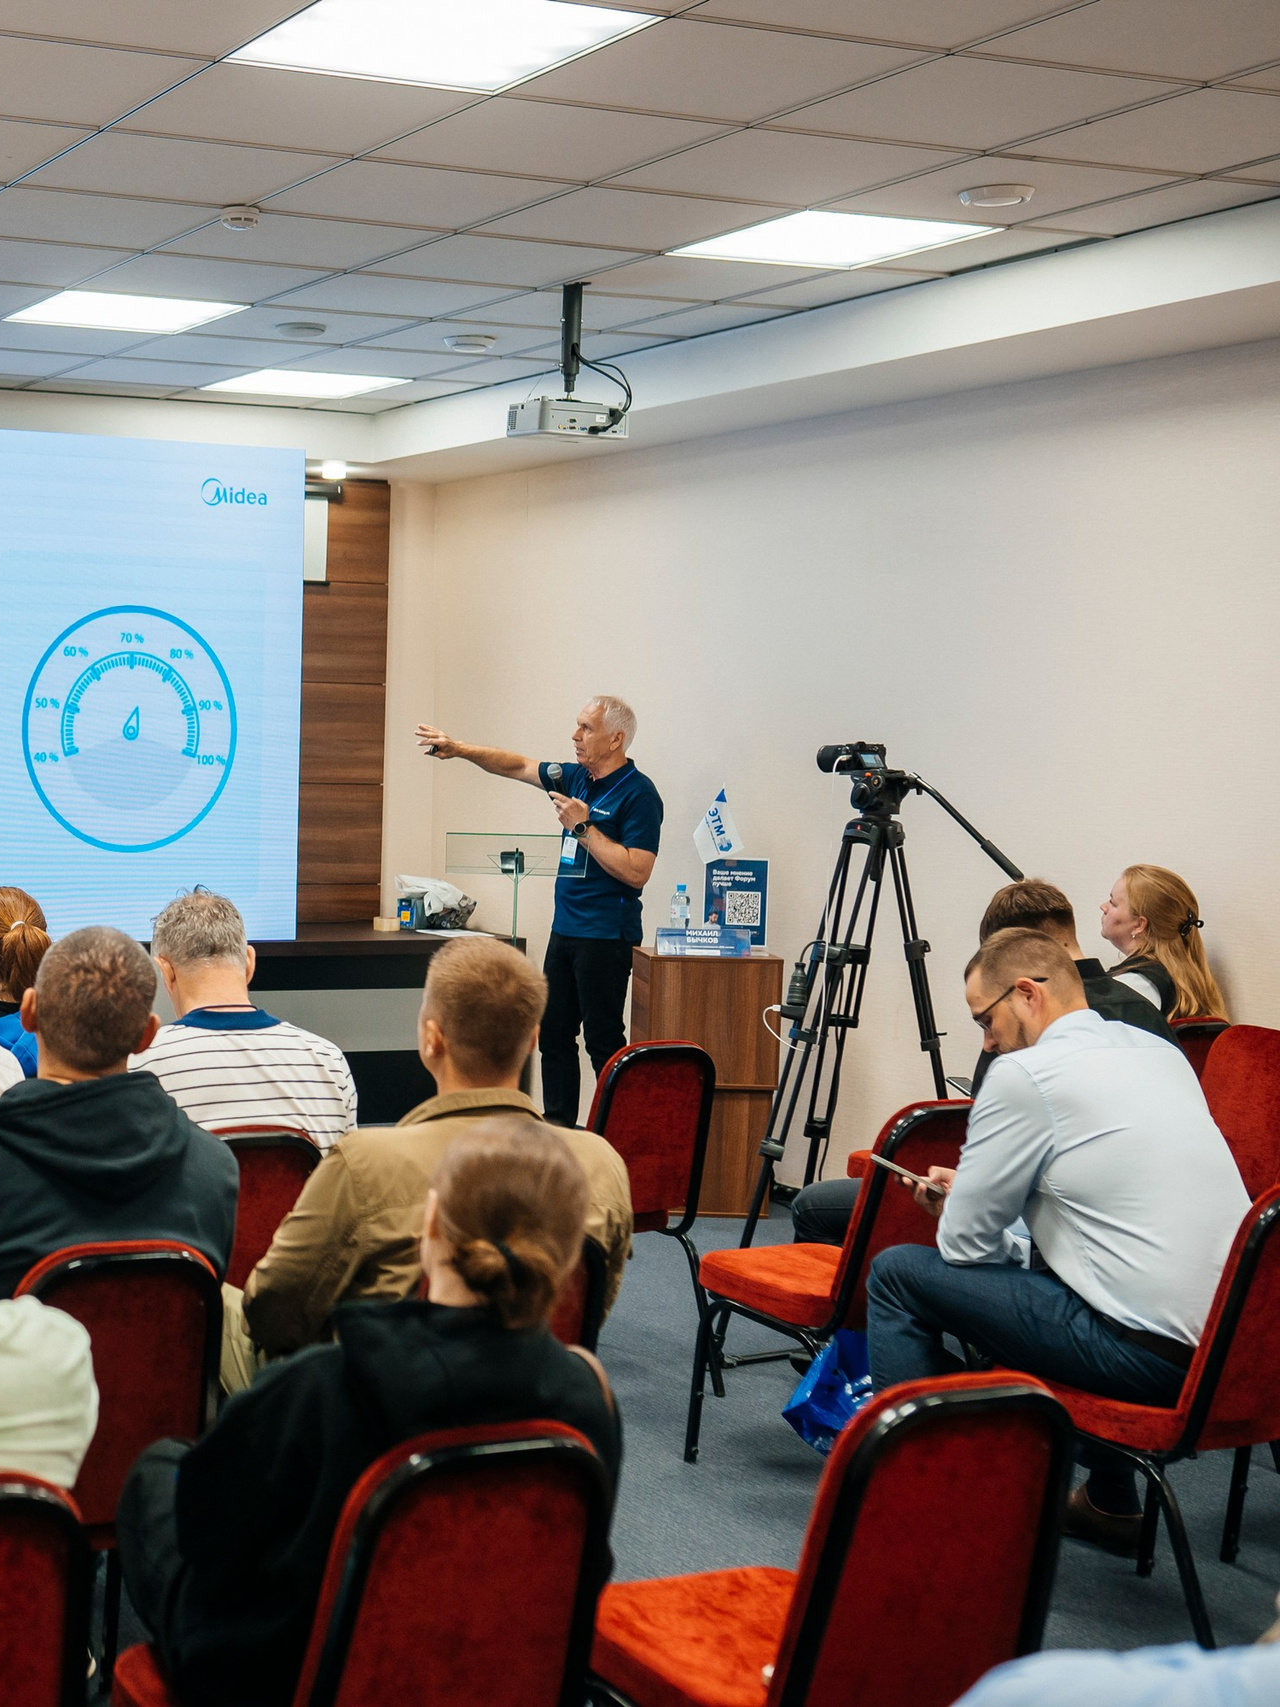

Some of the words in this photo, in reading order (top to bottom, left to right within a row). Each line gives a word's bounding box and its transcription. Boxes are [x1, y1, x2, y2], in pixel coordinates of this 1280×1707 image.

[201, 478, 267, 506] Midea
[120, 633, 132, 644] 70
[133, 633, 143, 644] %
[63, 646, 75, 657] 60
[77, 647, 88, 657] %
[170, 648, 181, 659] 80
[183, 648, 194, 659] %
[35, 698, 47, 709] 50
[49, 699, 59, 709] %
[199, 700, 210, 710] 90
[212, 700, 222, 711] %
[34, 752, 47, 762] 40
[48, 752, 58, 762] %
[197, 755, 214, 765] 100
[216, 756, 225, 765] %
[709, 808, 725, 836] ЭТМ
